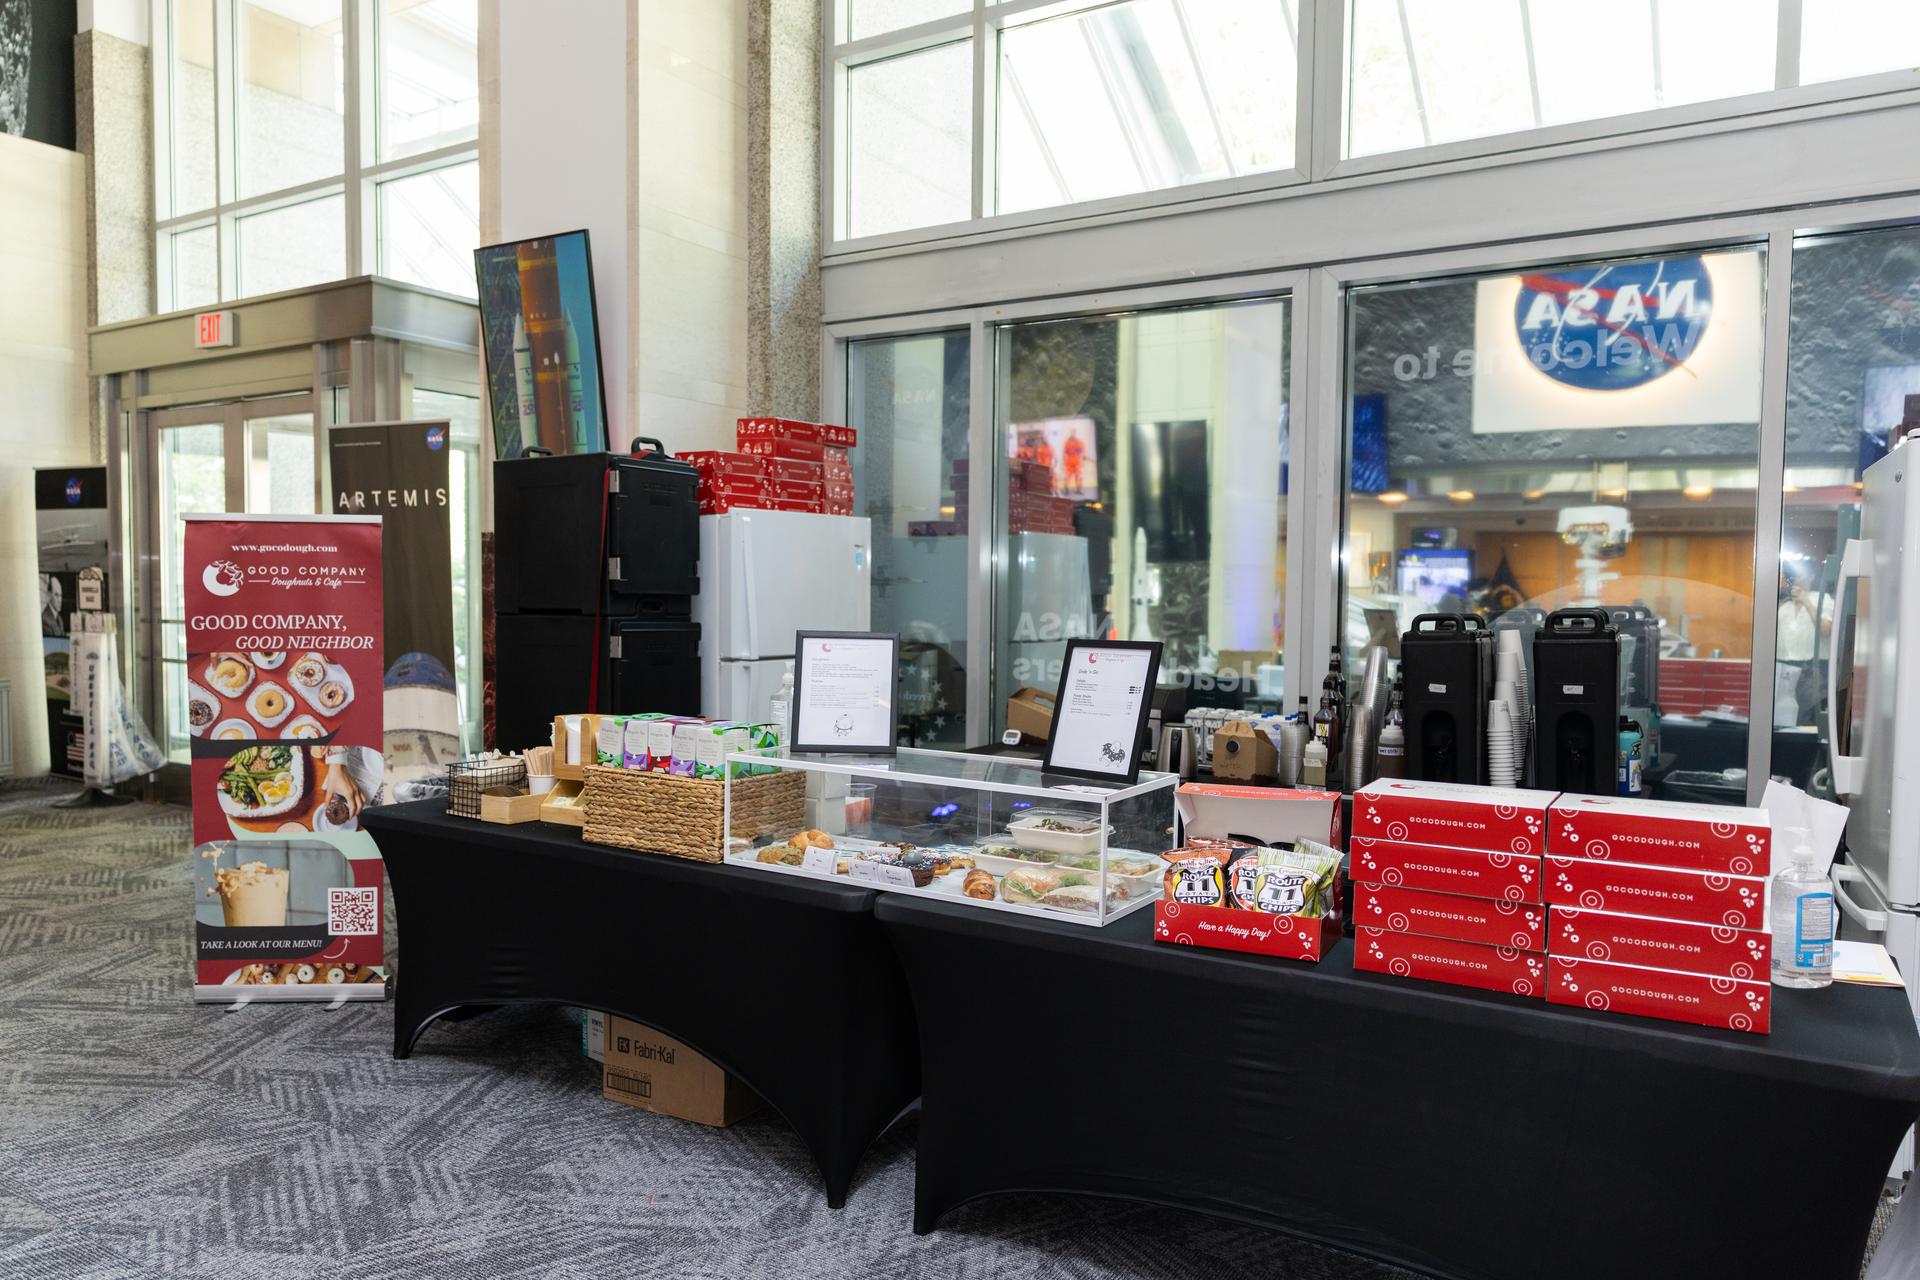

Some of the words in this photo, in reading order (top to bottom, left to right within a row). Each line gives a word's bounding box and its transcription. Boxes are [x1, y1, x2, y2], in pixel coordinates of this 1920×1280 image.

[200, 314, 221, 344] EXIT
[339, 488, 447, 508] ARTEMIS
[231, 543, 338, 553] www.gocodough.com
[247, 566, 290, 575] GOOD
[298, 566, 366, 576] COMPANY
[271, 577, 313, 589] Doughnuts
[315, 578, 321, 586] &
[191, 615, 248, 630] GOOD
[252, 615, 347, 632] COMPANY,
[236, 636, 284, 649] GOOD
[287, 636, 374, 649] NEIGHBOR
[1409, 816, 1486, 830] GOCODOUGH.COM
[1612, 834, 1700, 849] GOCODOUGH.COM
[1182, 867, 1214, 880] ROUTE
[1238, 869, 1257, 878] ROU
[1404, 862, 1480, 878] GOCODOUGH.COM
[1267, 875, 1305, 887] ROUTE
[1269, 887, 1297, 901] 11
[1605, 884, 1694, 902] GOCODOUGH.COM
[1261, 902, 1297, 912] CHIPS
[1410, 908, 1486, 924] GOCODOUGH.COM
[1199, 921, 1217, 932] Have
[1225, 924, 1250, 937] Happy
[1251, 927, 1271, 941] Day!
[201, 940, 224, 950] TAKE
[225, 941, 232, 949] A
[234, 940, 259, 949] LOOK
[260, 940, 271, 949] AT
[272, 940, 292, 948] OUR
[292, 939, 323, 948] MENU!
[1612, 936, 1701, 953] GOCODOUGH.COM
[1411, 953, 1488, 970] GOCODOUGH.COM
[1611, 985, 1700, 1004] GOCODOUGH.COM
[634, 1040, 675, 1064] Fabri-Kal
